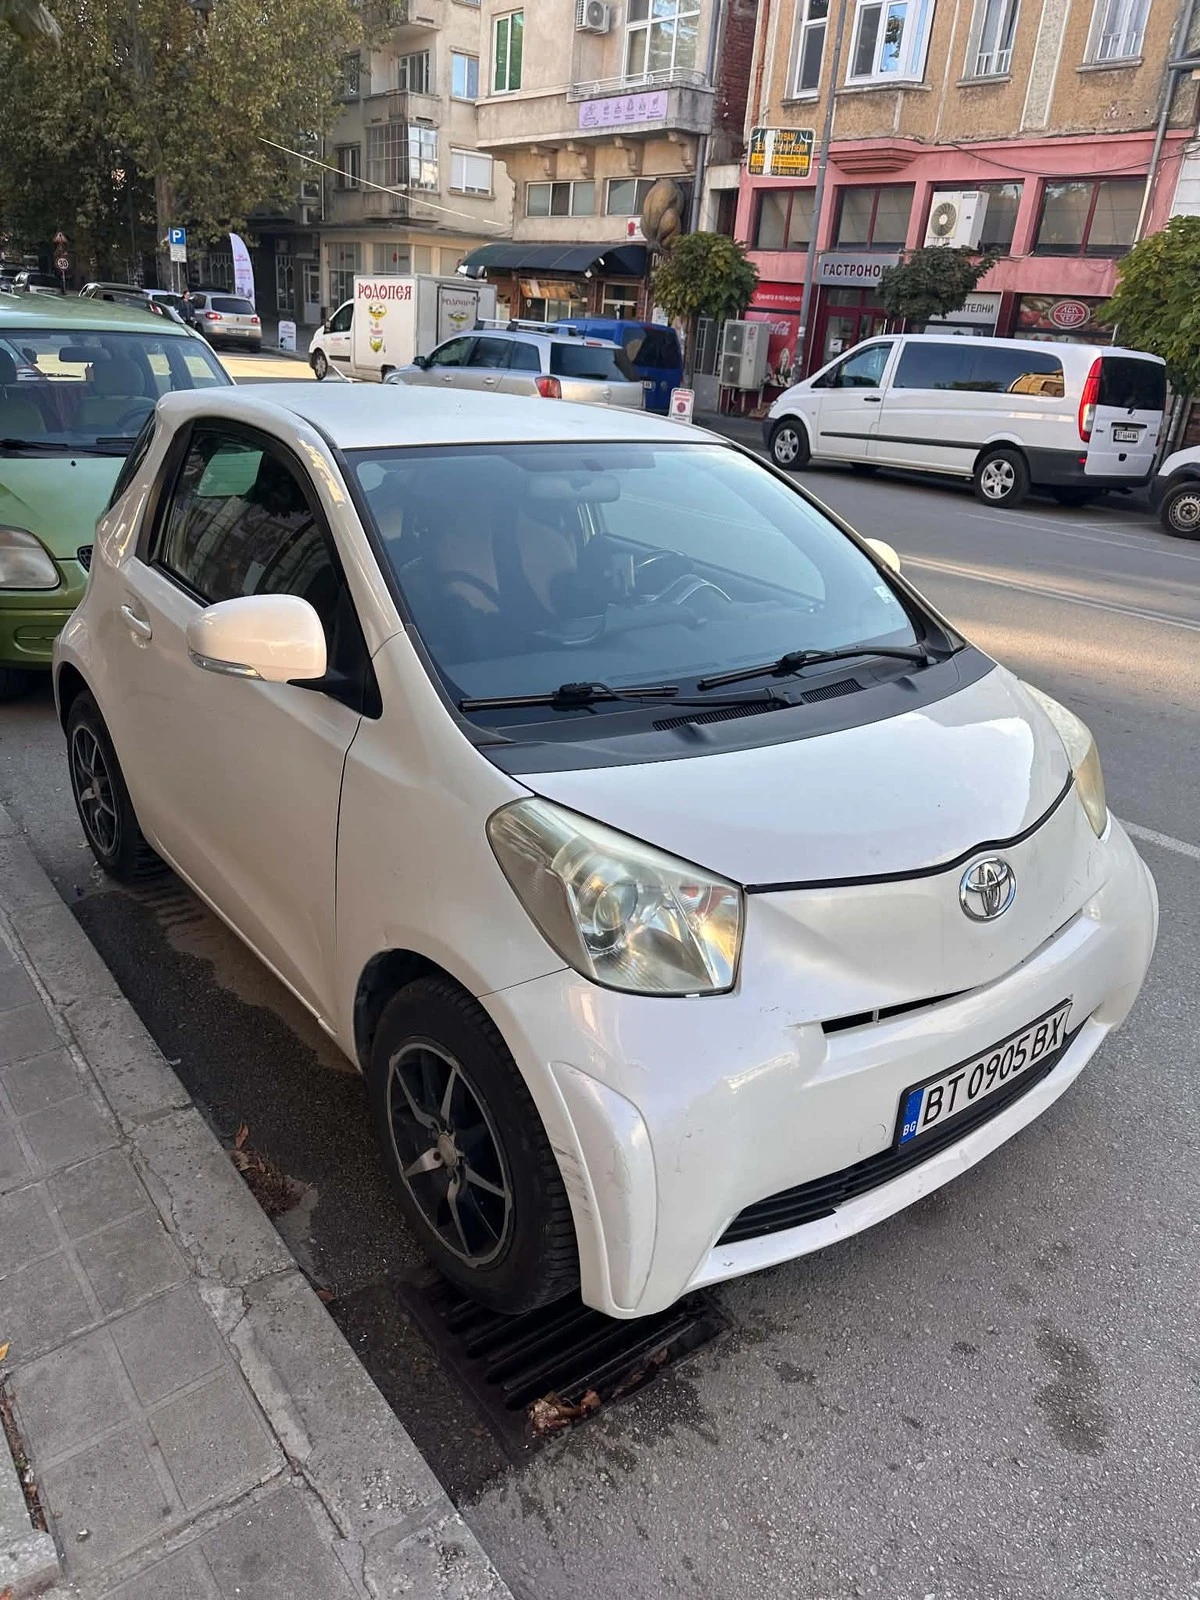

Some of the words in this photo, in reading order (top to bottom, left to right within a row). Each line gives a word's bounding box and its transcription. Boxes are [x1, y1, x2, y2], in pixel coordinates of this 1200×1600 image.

[172, 230, 182, 242] P
[58, 259, 68, 268] 30
[823, 263, 890, 278] ГАСТРОНО
[357, 282, 413, 300] РОДОПЕЯ
[967, 1034, 1031, 1100] 0905
[902, 1120, 917, 1137] BG
